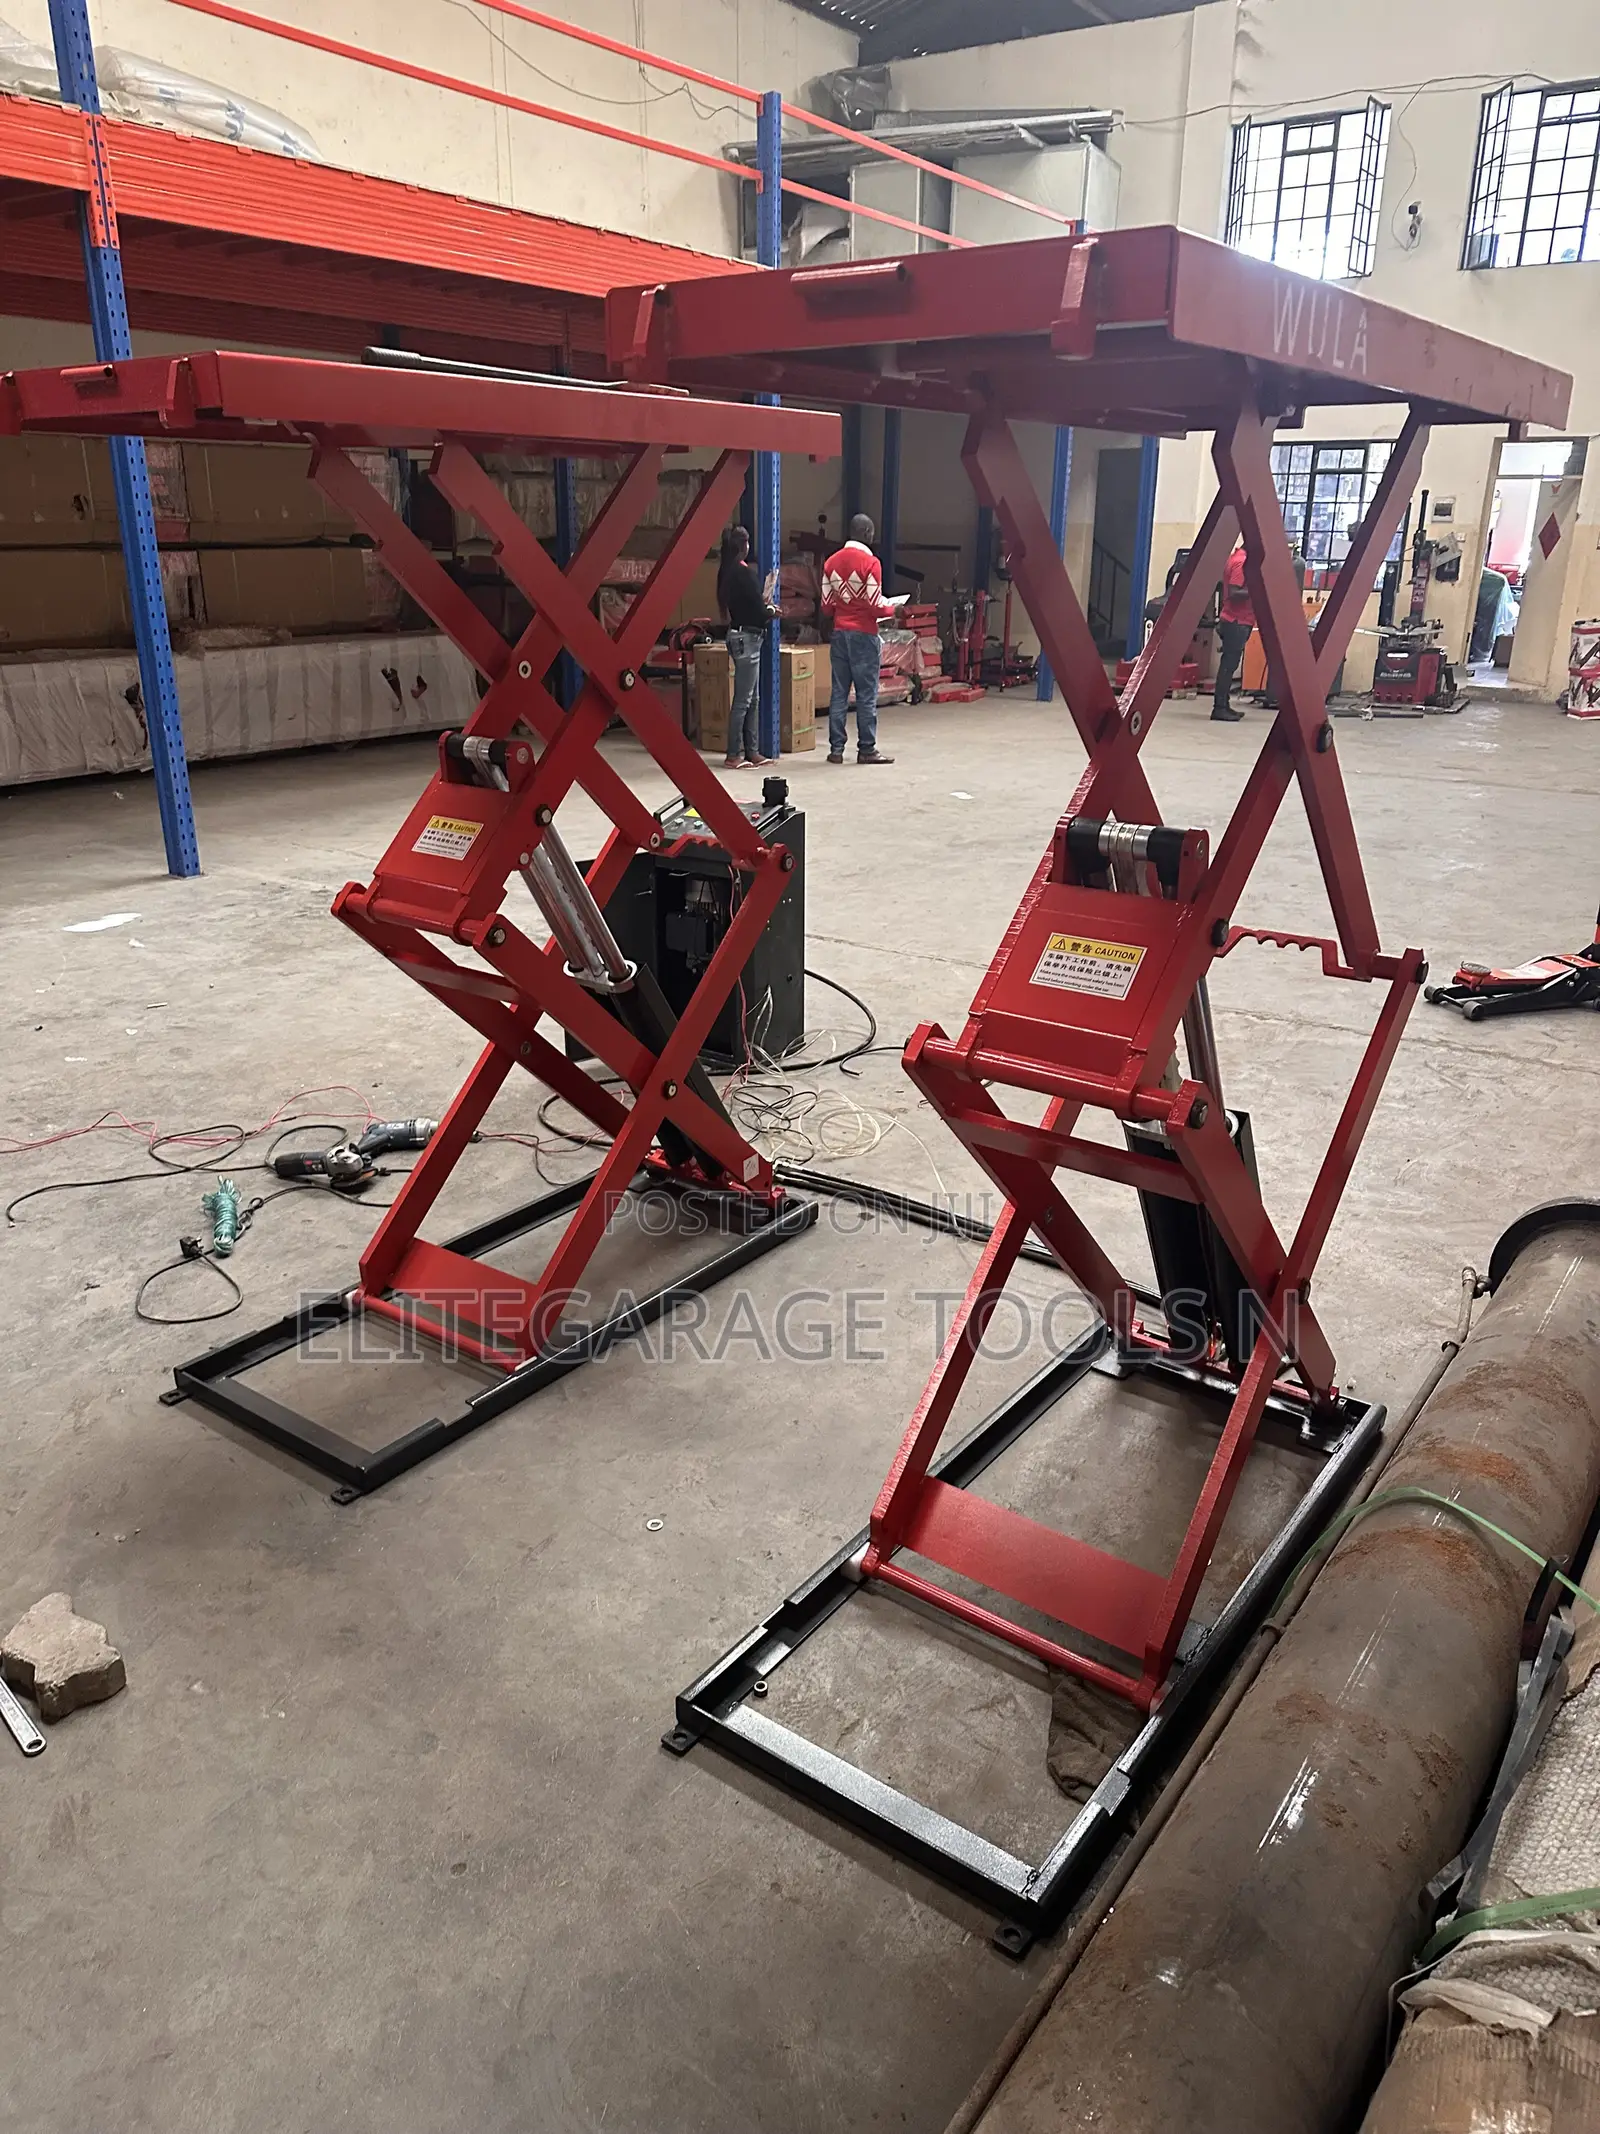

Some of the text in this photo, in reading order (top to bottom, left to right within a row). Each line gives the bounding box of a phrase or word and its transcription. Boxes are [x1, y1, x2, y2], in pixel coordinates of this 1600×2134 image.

[1273, 278, 1367, 376] WULA
[1070, 942, 1136, 961] 警告 CAUTION
